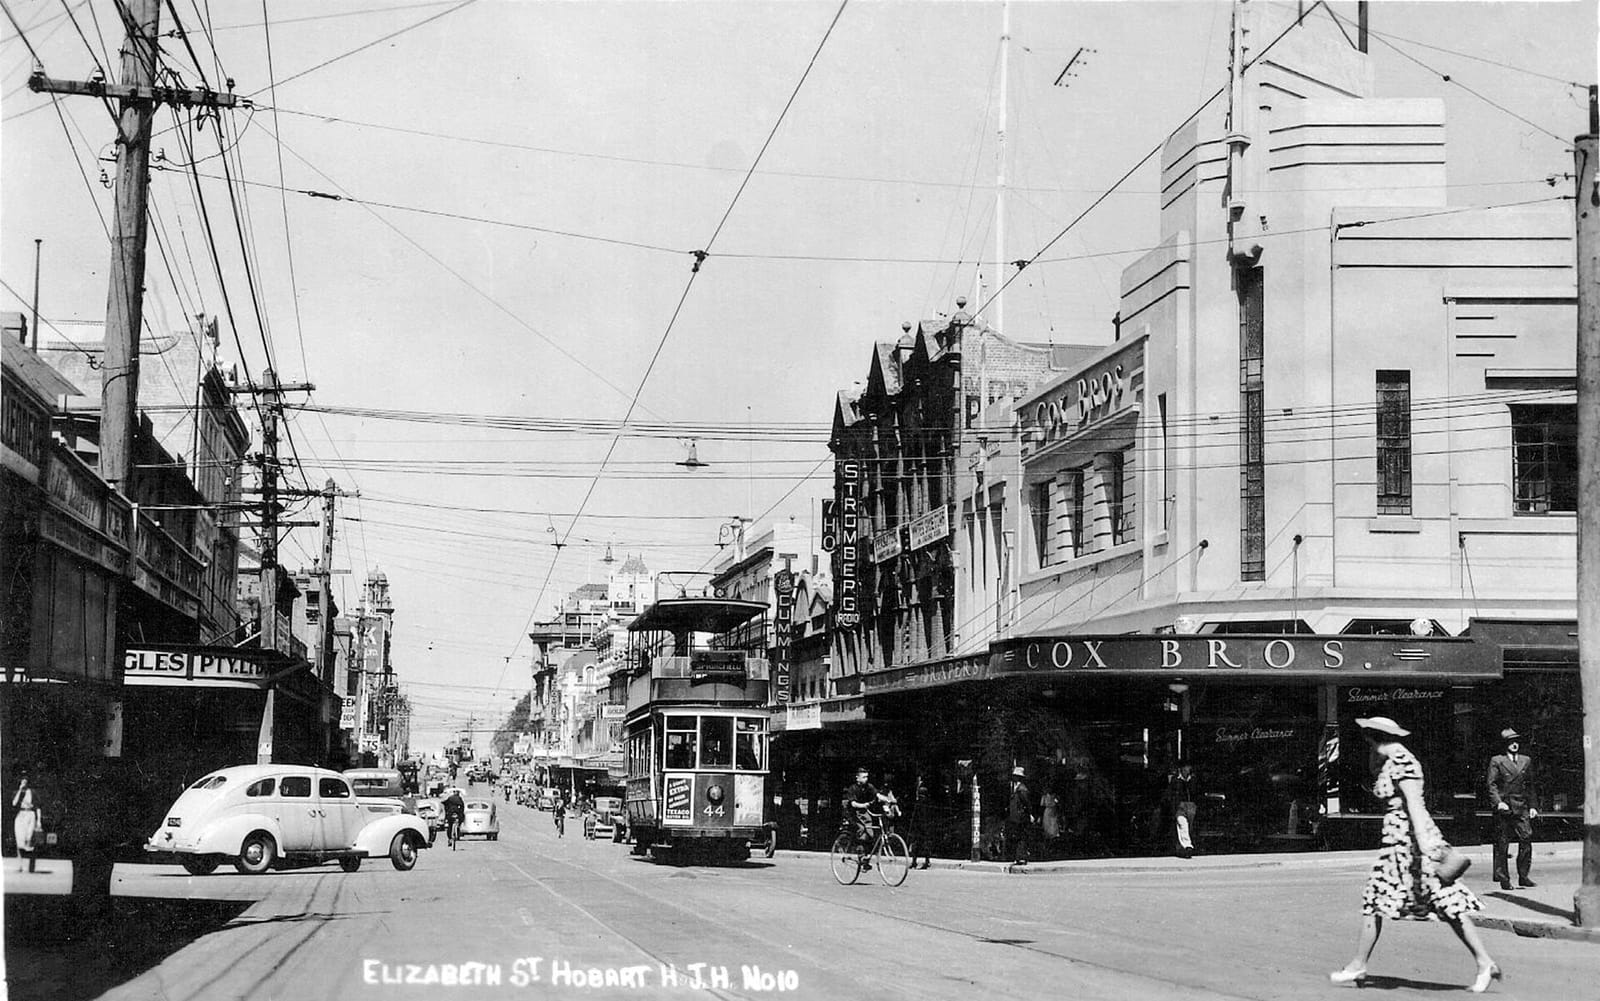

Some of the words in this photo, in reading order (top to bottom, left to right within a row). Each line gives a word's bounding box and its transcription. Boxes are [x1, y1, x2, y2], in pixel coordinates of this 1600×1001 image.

[843, 465, 858, 611] STROMBERG
[1026, 641, 1108, 670] COX
[1160, 640, 1372, 669] BROS.
[1347, 687, 1389, 702] Summer
[1392, 688, 1444, 699] Clearance
[703, 804, 726, 817] 44
